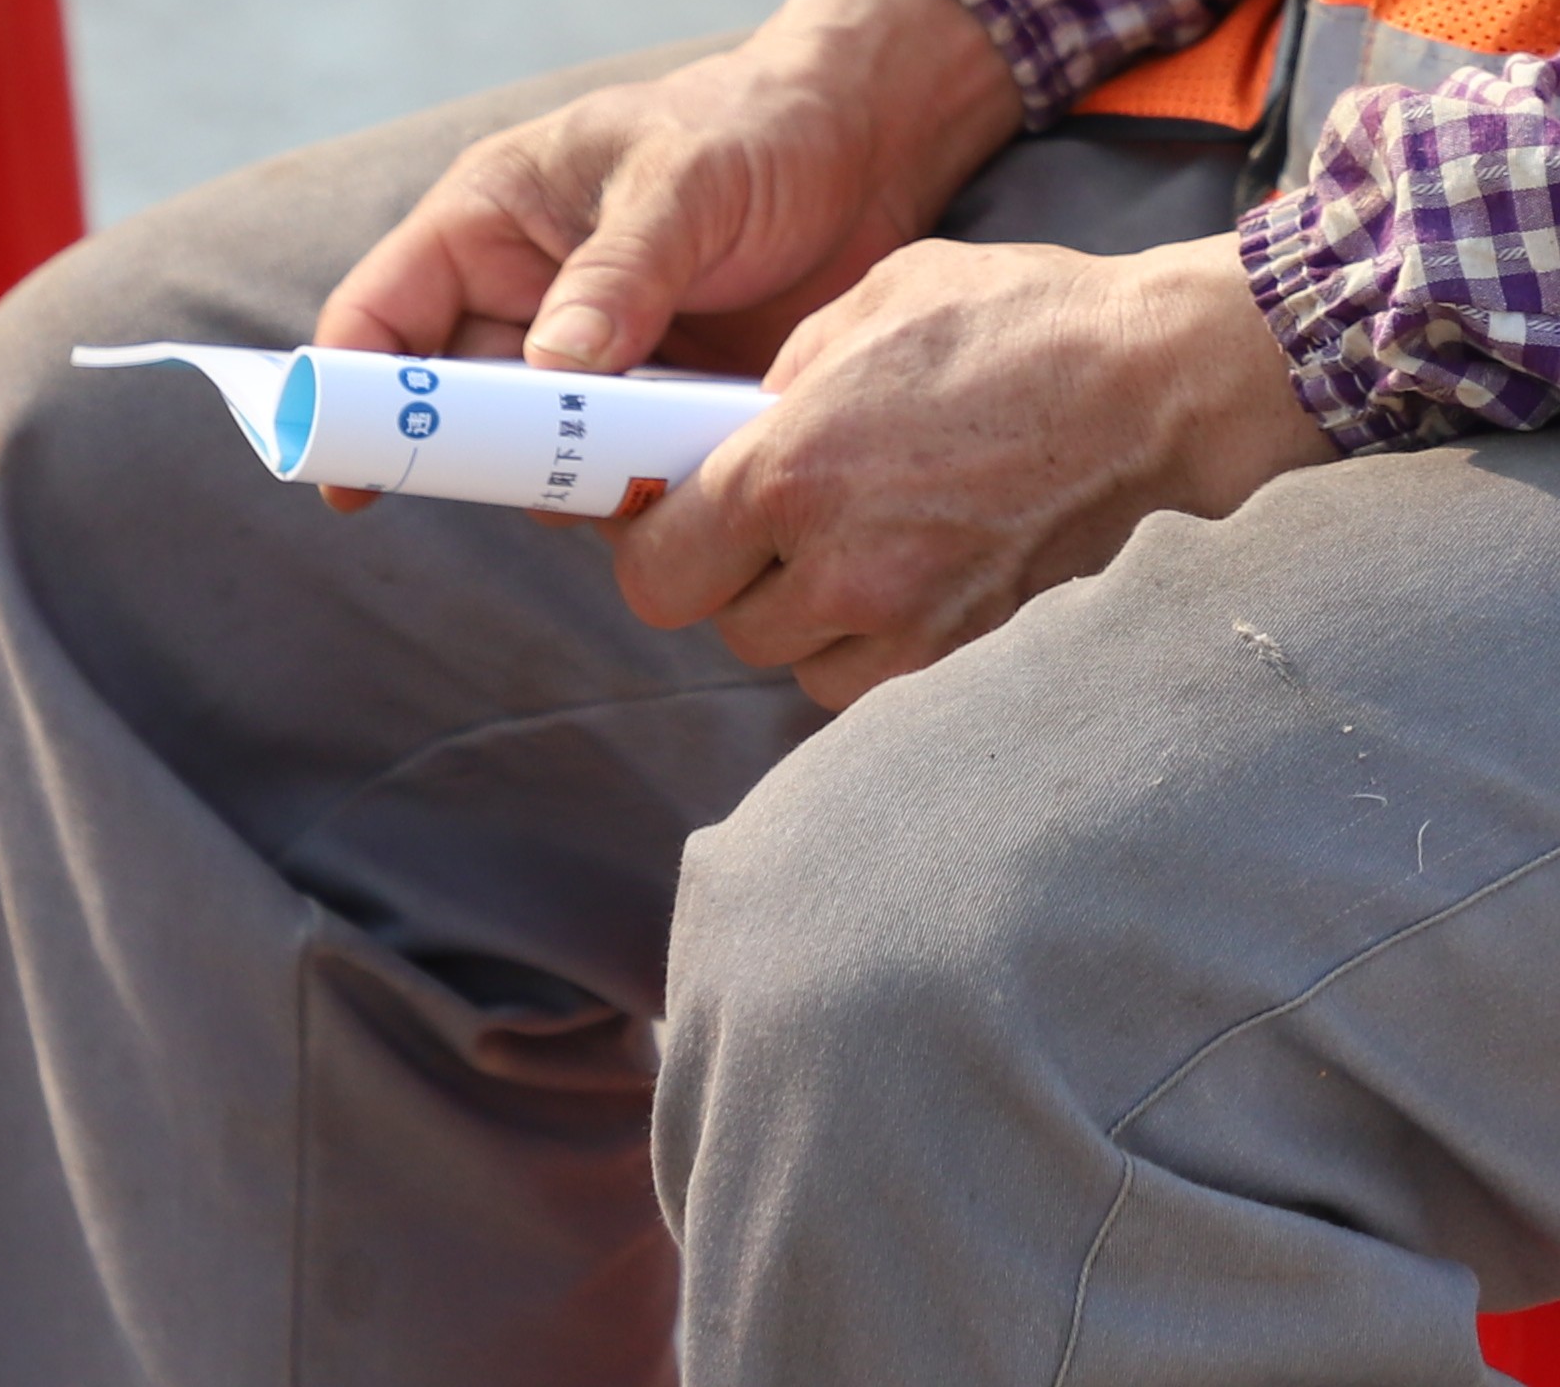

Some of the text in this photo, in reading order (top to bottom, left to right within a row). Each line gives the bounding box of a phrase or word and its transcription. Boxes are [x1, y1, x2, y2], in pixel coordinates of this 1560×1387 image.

[532, 393, 587, 510] 太阳下暴晒
